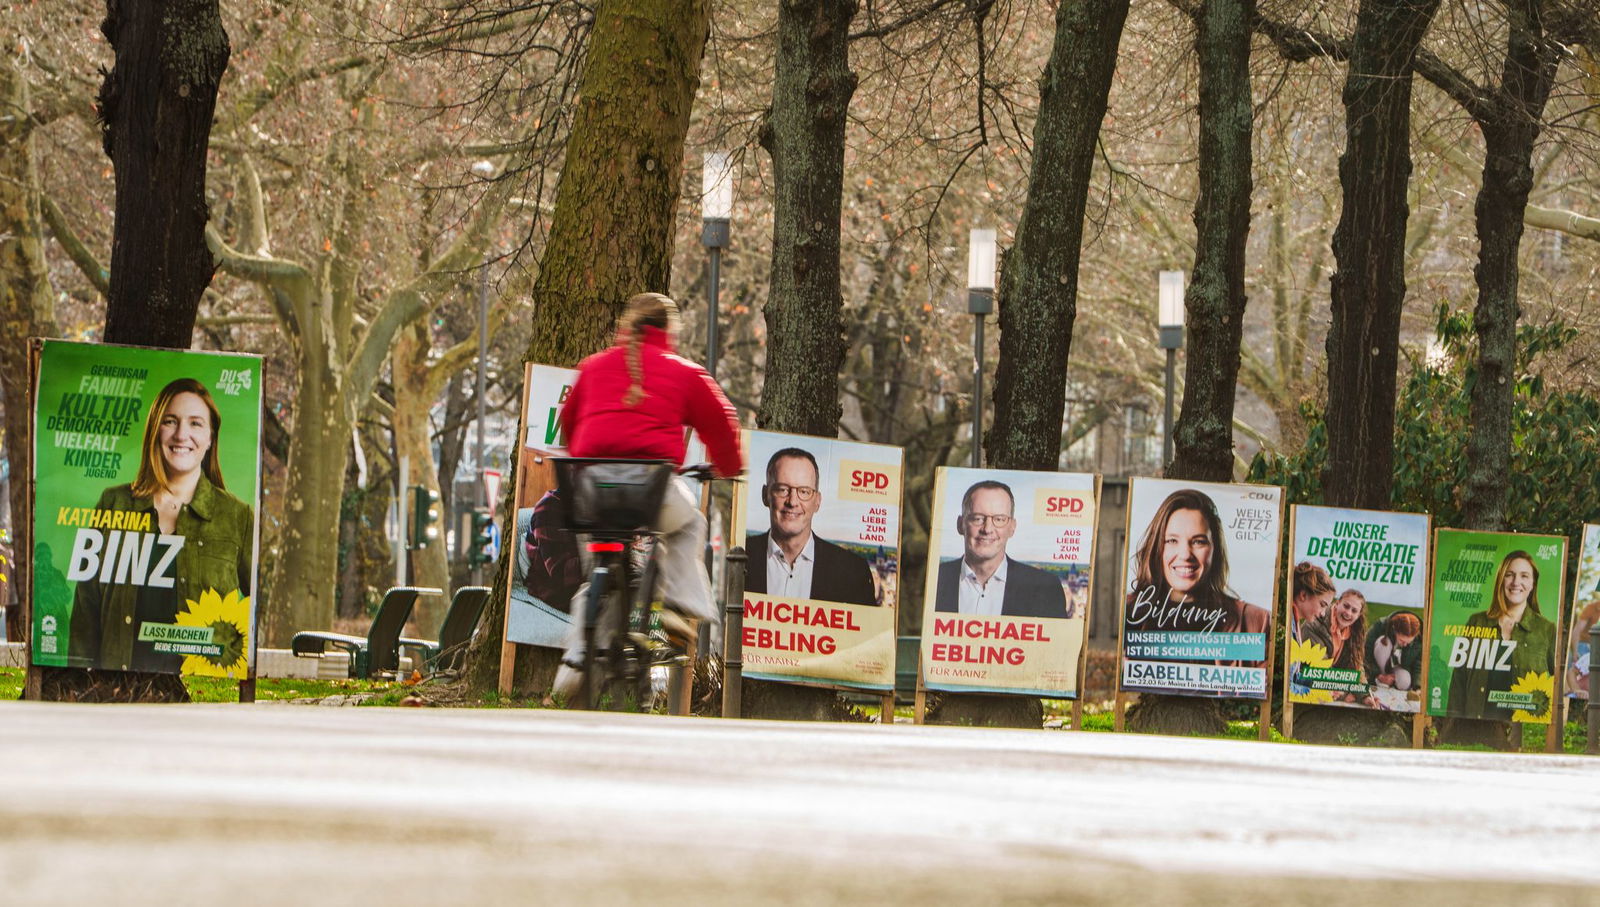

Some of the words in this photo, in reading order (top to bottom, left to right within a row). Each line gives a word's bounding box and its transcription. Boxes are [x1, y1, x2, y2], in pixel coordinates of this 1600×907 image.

[90, 365, 148, 379] GEMEINSAM
[220, 370, 237, 382] DU
[79, 376, 145, 397] FAMILIE
[58, 393, 142, 422] KULTUR
[46, 416, 131, 436] DEMOKRATIE
[54, 432, 119, 451] VIELFALT
[64, 449, 122, 470] KINDER
[84, 468, 117, 479] JUGEND
[851, 470, 889, 490] SPD
[1249, 492, 1273, 500] CDU
[1046, 497, 1084, 512] SPD
[57, 507, 150, 531] KATHARINA
[869, 508, 887, 516] AUS
[862, 516, 887, 524] LIEBE
[1228, 518, 1272, 530] JETZT
[866, 525, 886, 533] ZUM
[1236, 530, 1259, 540] GILT
[1333, 521, 1389, 541] UNSERE
[859, 533, 886, 542] LAND.
[67, 528, 186, 588] BINZ
[1307, 537, 1418, 565] DEMOKRATIE
[1458, 550, 1495, 561] FAMILIE
[1447, 560, 1494, 575] KULTUR
[1441, 572, 1487, 584] DEMOKRATIE
[1444, 582, 1481, 592] VIELFALT
[1450, 591, 1482, 603] KINDER
[744, 599, 860, 631] MICHAEL
[1126, 580, 1227, 637] Bildung.
[144, 626, 166, 638] LASS
[166, 627, 209, 641] MACHEN!
[934, 618, 1051, 642] MICHAEL
[1444, 625, 1498, 639] KATHARINA
[742, 627, 836, 654] EBLING
[1127, 633, 1166, 643] UNSERE
[1169, 634, 1230, 644] WICHTIGSTE
[1233, 635, 1262, 644] BANK
[154, 642, 172, 652] BEIDE
[932, 643, 1025, 665] EBLING
[1127, 647, 1142, 656] IST
[1144, 647, 1159, 656] DIE
[1162, 647, 1226, 657] SCHULBANK!
[1448, 637, 1517, 671] BINZ
[741, 653, 762, 665] FÜR
[764, 656, 800, 667] MAINZ
[930, 666, 950, 676] FÜR
[953, 668, 987, 680] MAINZ
[1127, 663, 1194, 681] ISABELL
[1200, 667, 1262, 686] RAHMS
[1303, 668, 1322, 679] LASS
[1323, 670, 1358, 682] MACHEN!
[1210, 683, 1236, 692] Landtag
[1312, 680, 1350, 691] ZWEITSTIMME
